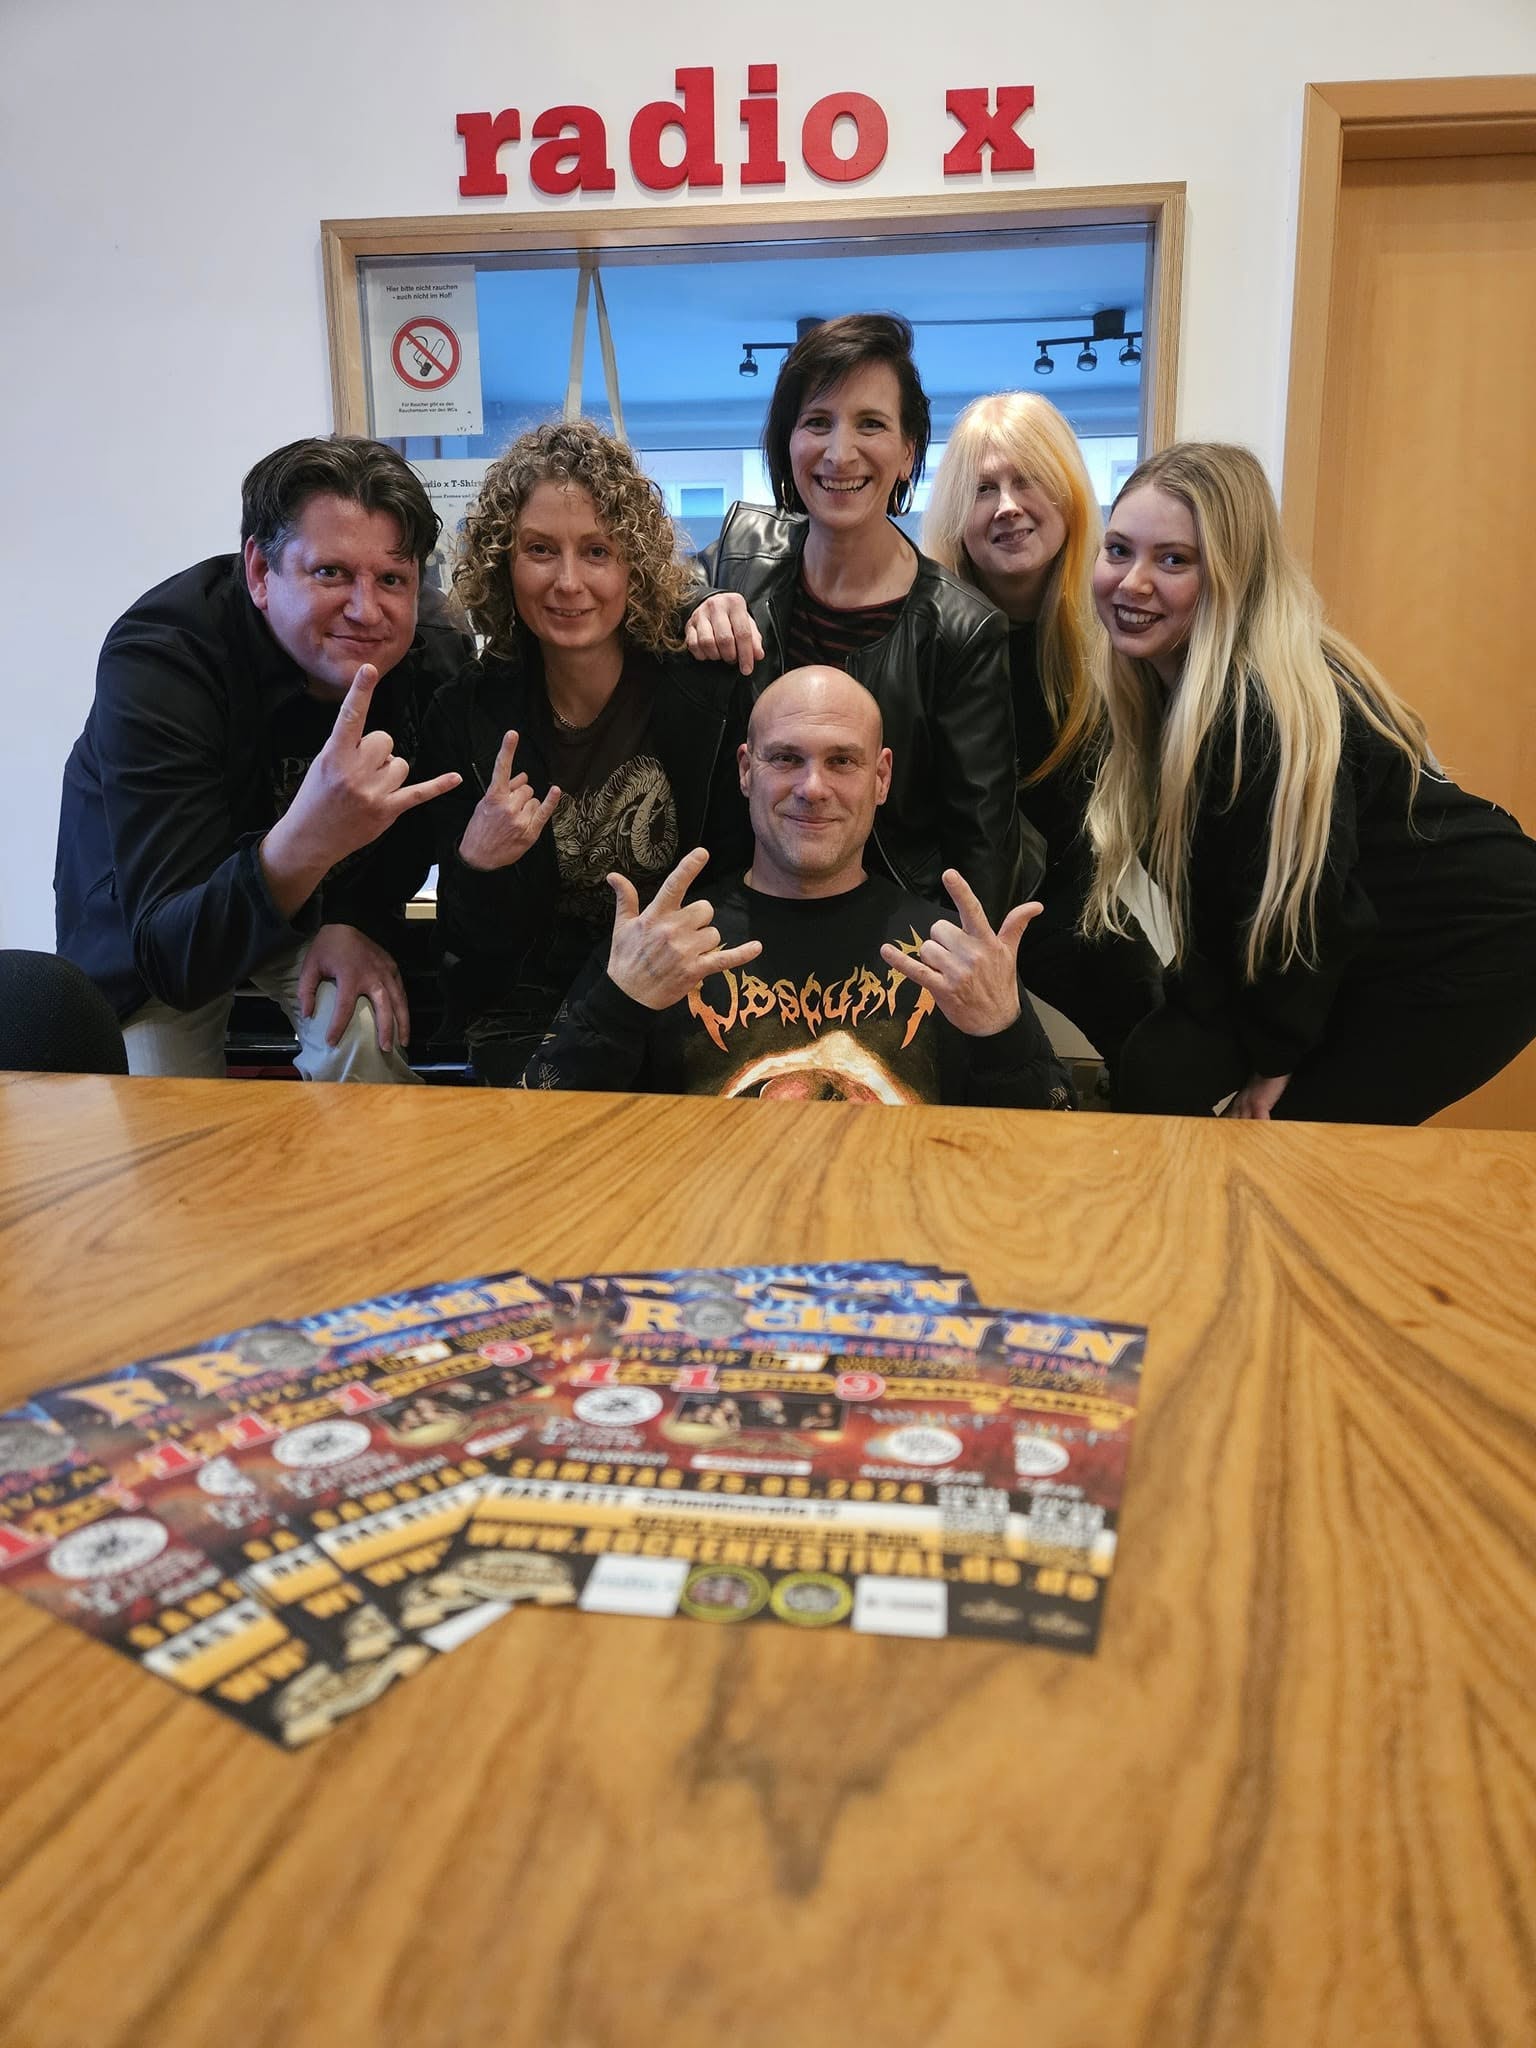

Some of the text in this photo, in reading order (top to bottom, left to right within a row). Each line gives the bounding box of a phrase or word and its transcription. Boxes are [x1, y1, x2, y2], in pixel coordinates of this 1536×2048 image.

[456, 64, 1035, 196] radio x
[400, 284, 414, 292] bitte
[415, 284, 431, 292] nicht
[432, 283, 458, 291] rauchen
